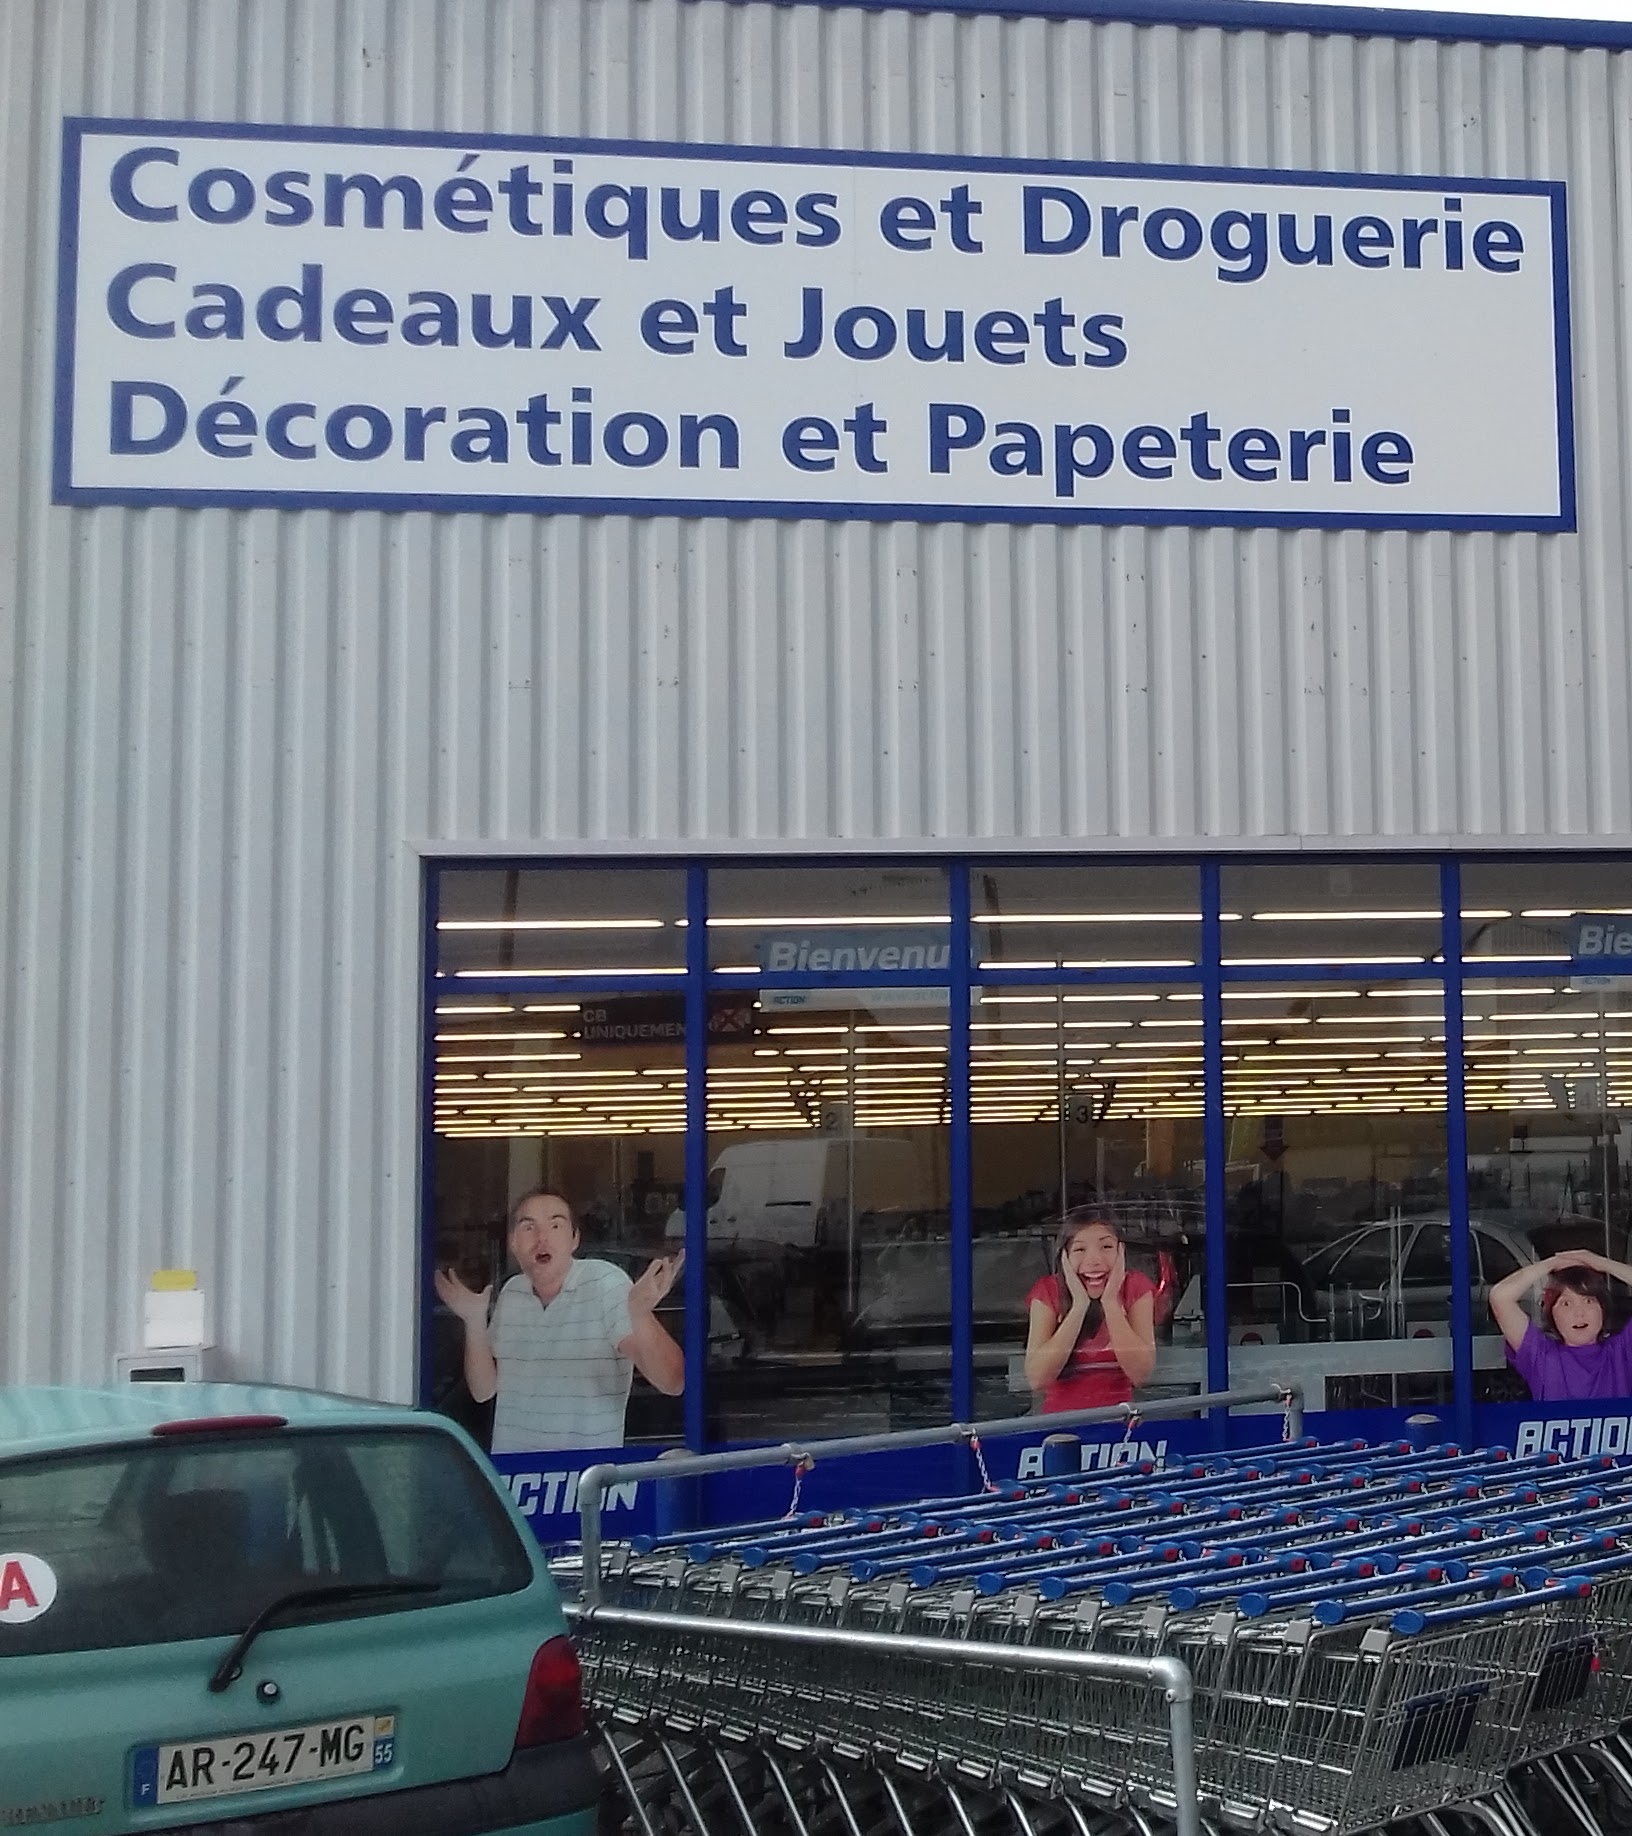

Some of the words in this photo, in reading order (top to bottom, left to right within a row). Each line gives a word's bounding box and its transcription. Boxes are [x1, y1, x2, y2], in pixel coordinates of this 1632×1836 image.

[109, 146, 840, 261] Cosmétiques
[879, 185, 983, 254] et
[1022, 184, 1525, 284] Droguerie
[106, 263, 602, 352] Cadeaux
[640, 285, 747, 357] et
[784, 286, 1128, 368] Jouets
[109, 376, 740, 471] Décoration
[781, 403, 888, 474] et
[928, 403, 1415, 498] Papeterie
[768, 940, 949, 971] Bienvenu
[583, 1022, 687, 1040] UNIQUEMEN
[1016, 1439, 1168, 1480] ATION
[500, 1470, 638, 1516] CTIN
[0, 1560, 39, 1611] A
[141, 1783, 150, 1796] F
[165, 1724, 366, 1792] AR-247-MG
[374, 1743, 393, 1764] 55
